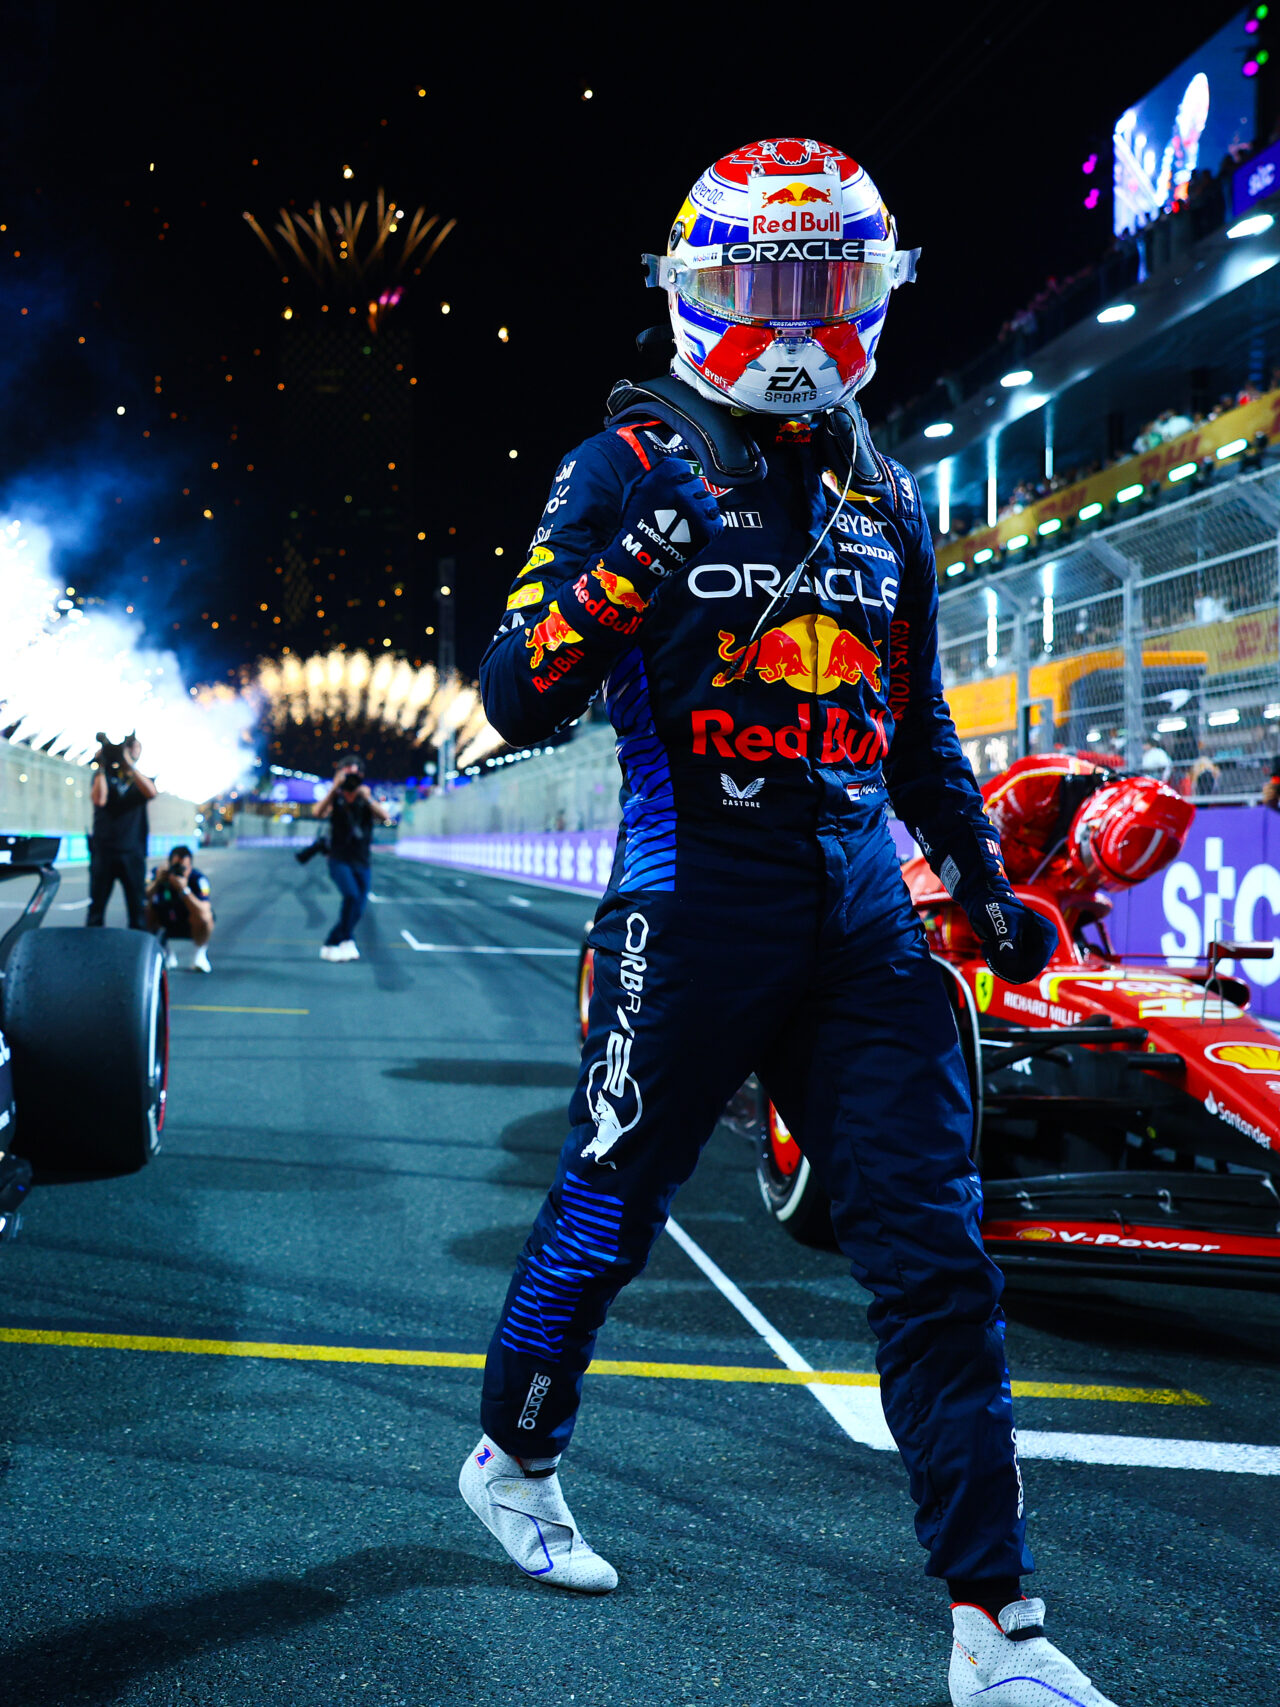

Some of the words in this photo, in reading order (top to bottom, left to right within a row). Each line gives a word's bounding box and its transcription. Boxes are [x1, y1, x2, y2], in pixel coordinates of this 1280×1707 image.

[753, 211, 797, 235] Red
[800, 211, 840, 232] Bull
[728, 241, 859, 263] ORACLE
[766, 367, 817, 391] EA
[764, 390, 817, 404] SPORTS
[636, 518, 687, 564] inter.mx
[836, 513, 888, 541] BYBIT
[838, 542, 897, 564] HONDA
[687, 563, 899, 614] ORACLE
[572, 573, 601, 617] Red
[597, 599, 643, 635] Bull
[531, 664, 560, 694] Red
[556, 647, 585, 672] Bull
[691, 702, 811, 762] Red
[820, 706, 889, 765] Bull
[722, 799, 761, 809] CASTORE
[988, 902, 1008, 935] sparco
[1161, 837, 1280, 987] stc
[1003, 990, 1049, 1018] RICHARD
[1217, 1100, 1272, 1150] Santander
[1059, 1230, 1221, 1252] V-Power
[522, 1374, 552, 1431] sparco
